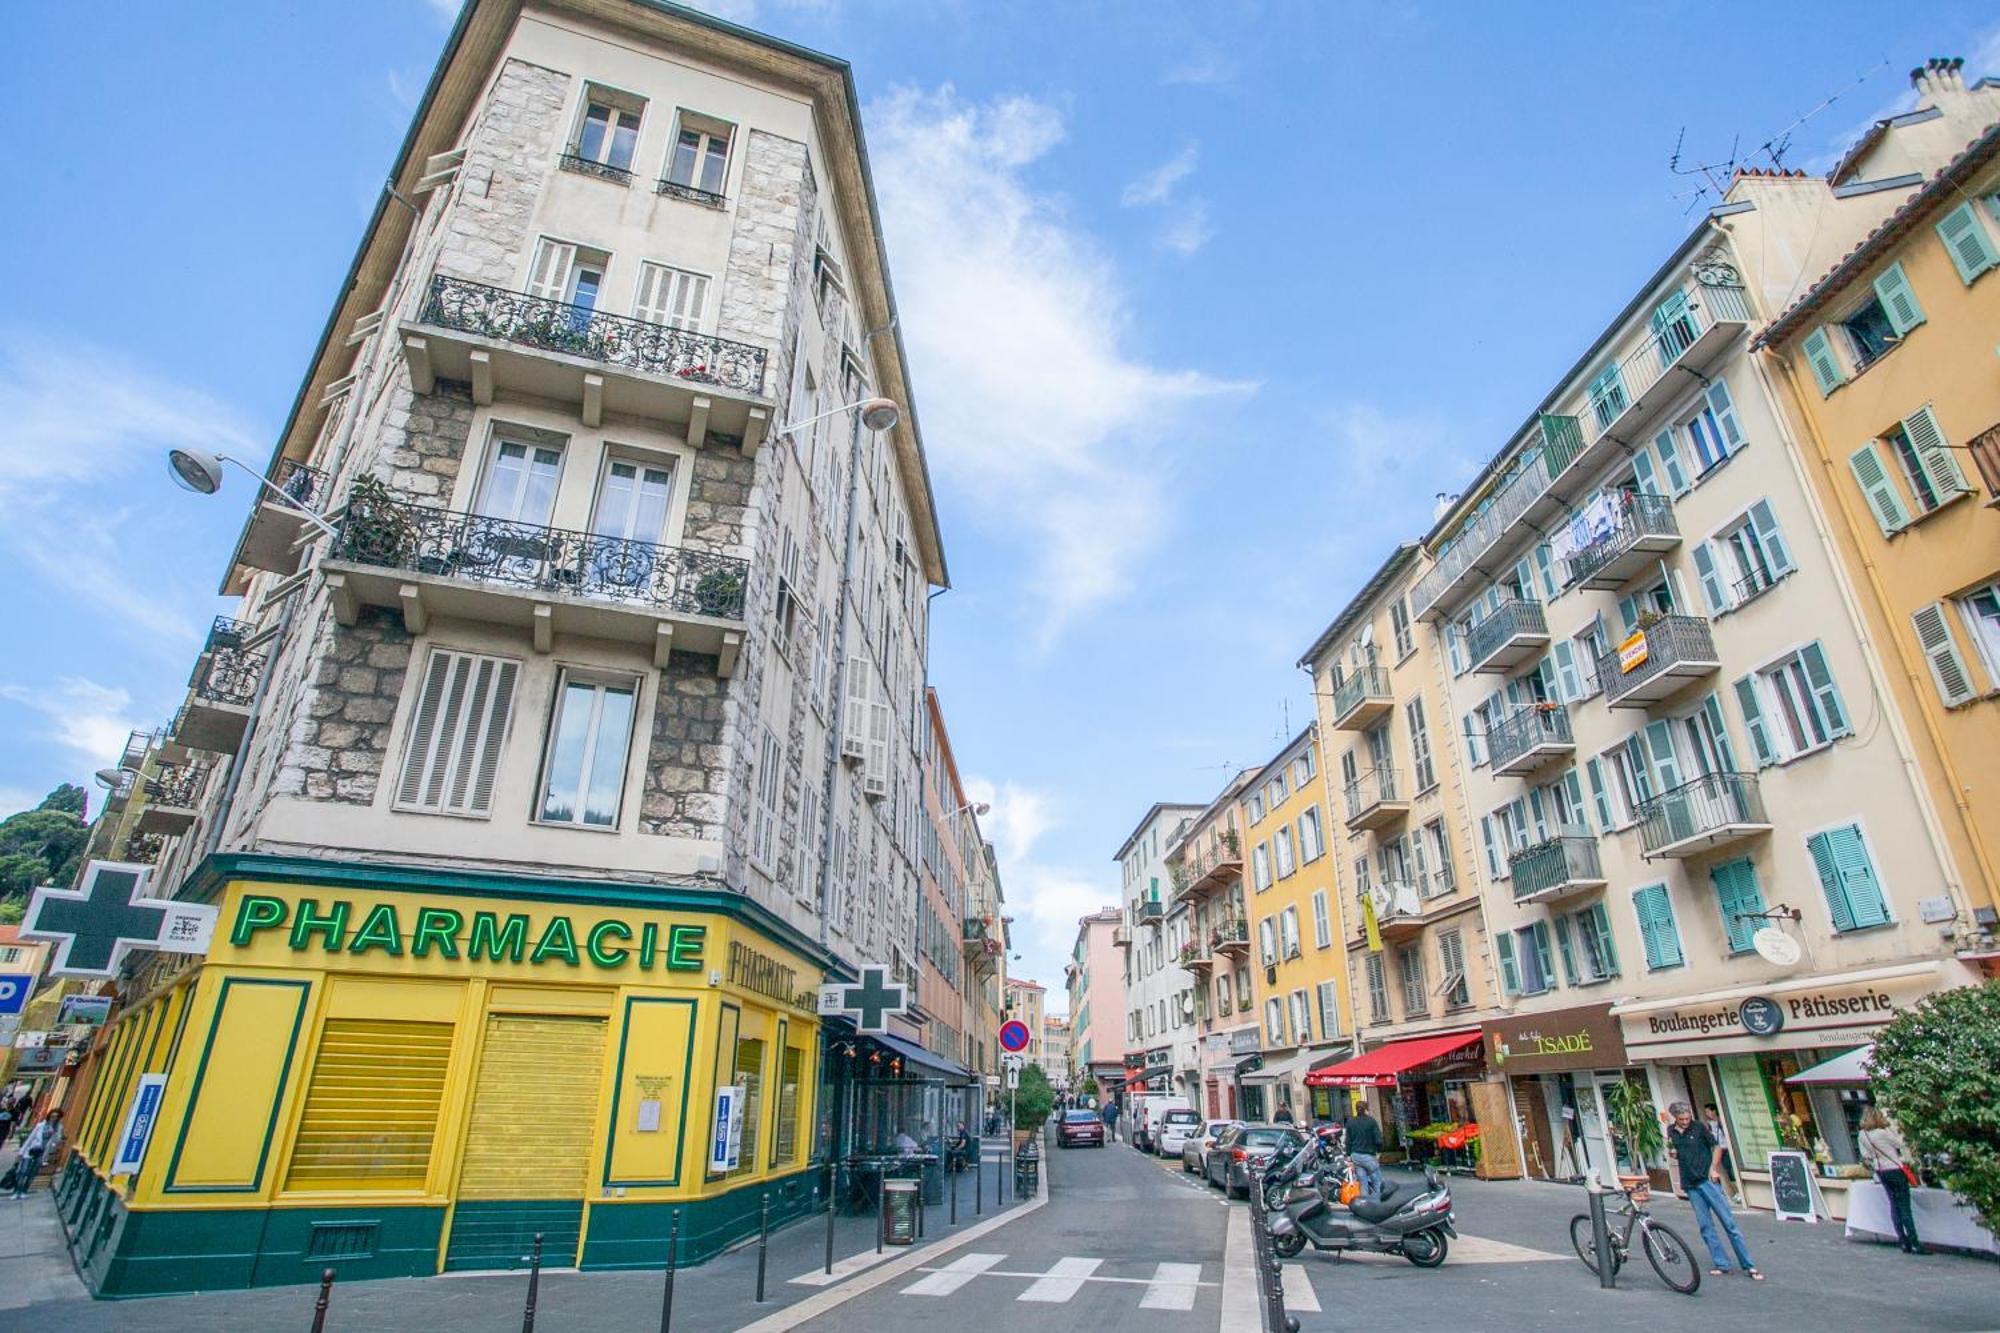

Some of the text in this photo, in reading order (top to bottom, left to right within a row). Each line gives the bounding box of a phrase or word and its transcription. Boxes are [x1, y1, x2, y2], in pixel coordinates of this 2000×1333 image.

[230, 895, 707, 971] PHARMACIE
[727, 941, 796, 1005] PHARMACIE
[1788, 989, 1892, 1018] Pâtisserie
[1649, 1007, 1740, 1034] Boulangerie
[1534, 1028, 1593, 1054] TSADÉ
